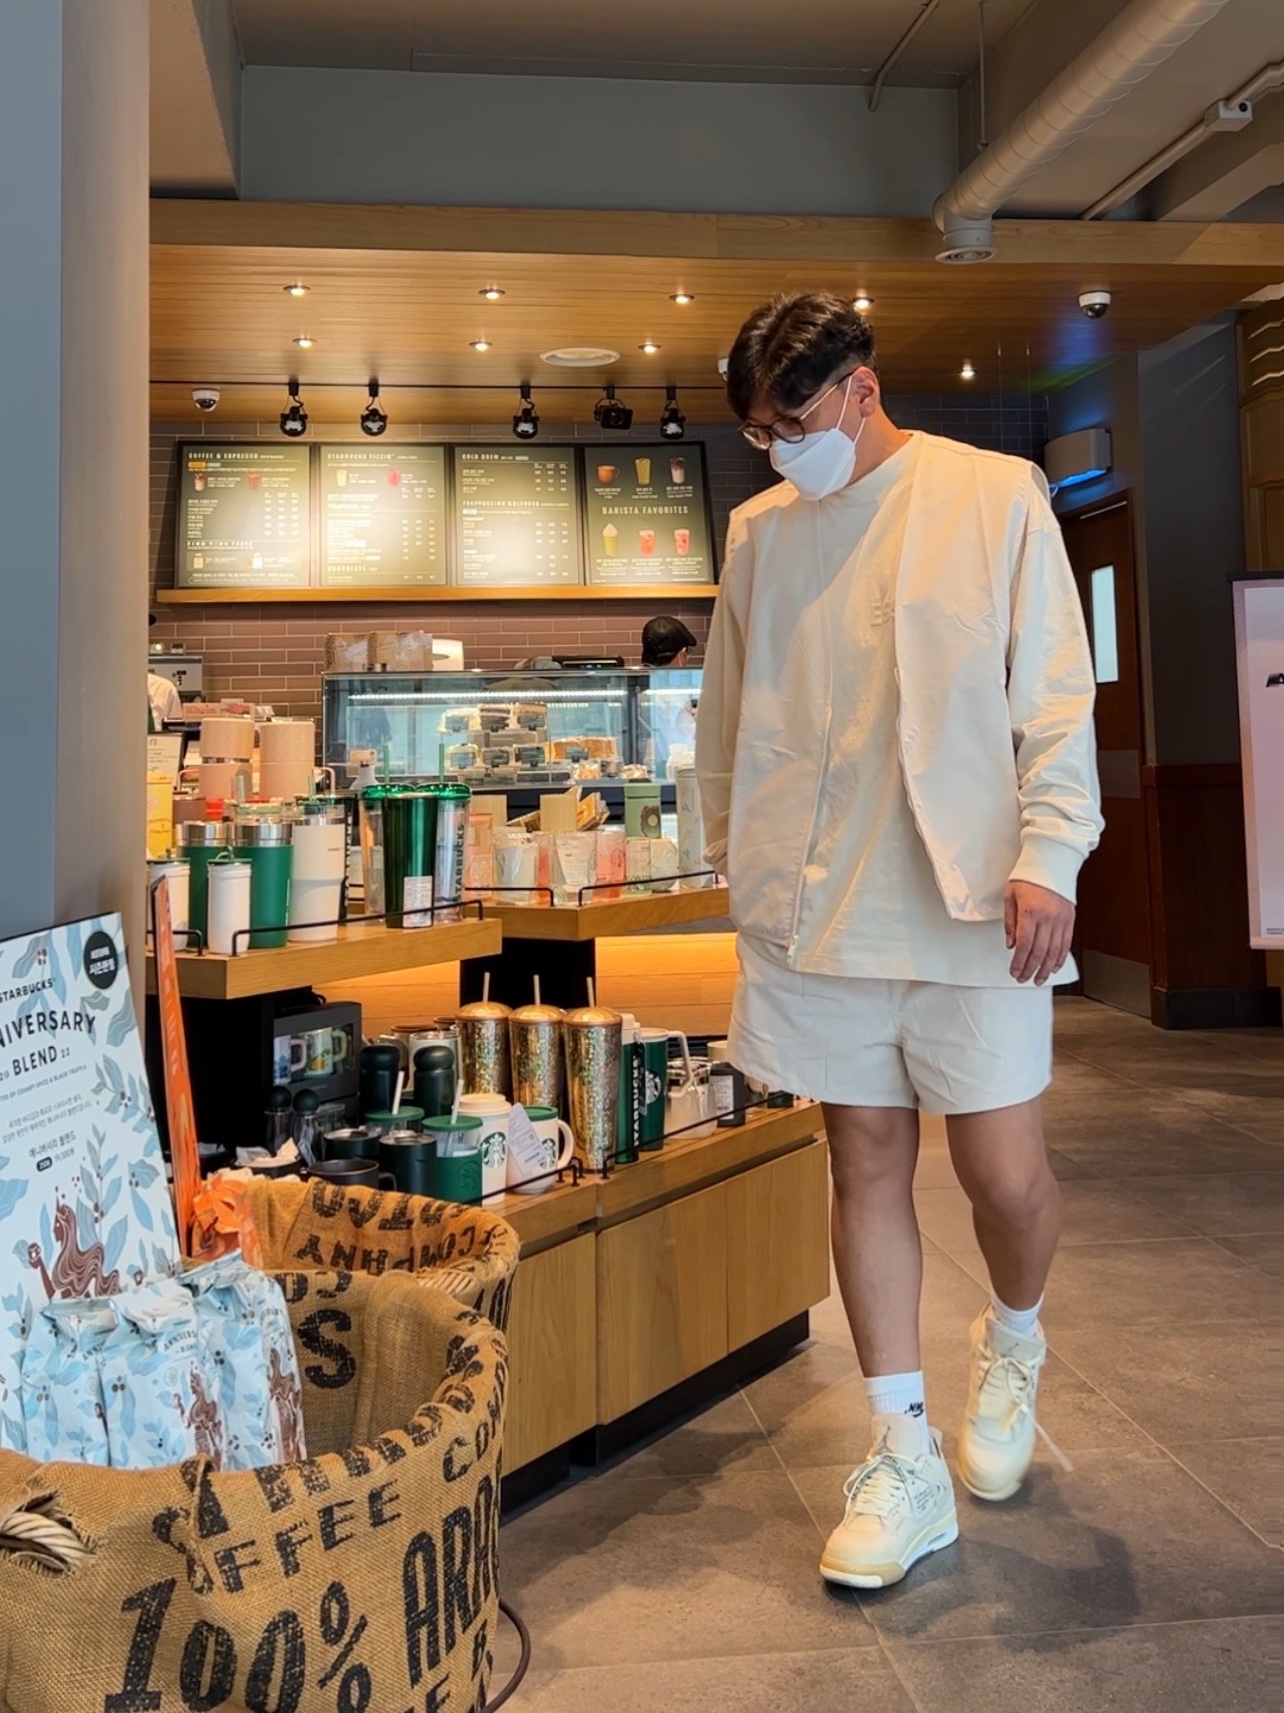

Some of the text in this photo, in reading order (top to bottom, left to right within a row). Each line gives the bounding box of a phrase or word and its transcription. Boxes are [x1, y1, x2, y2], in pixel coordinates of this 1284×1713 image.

[602, 505, 688, 515] BARISTA FAVORITES
[455, 824, 465, 903] STARBUCKS
[12, 1045, 57, 1076] BLEND
[104, 1577, 371, 1713] 100%
